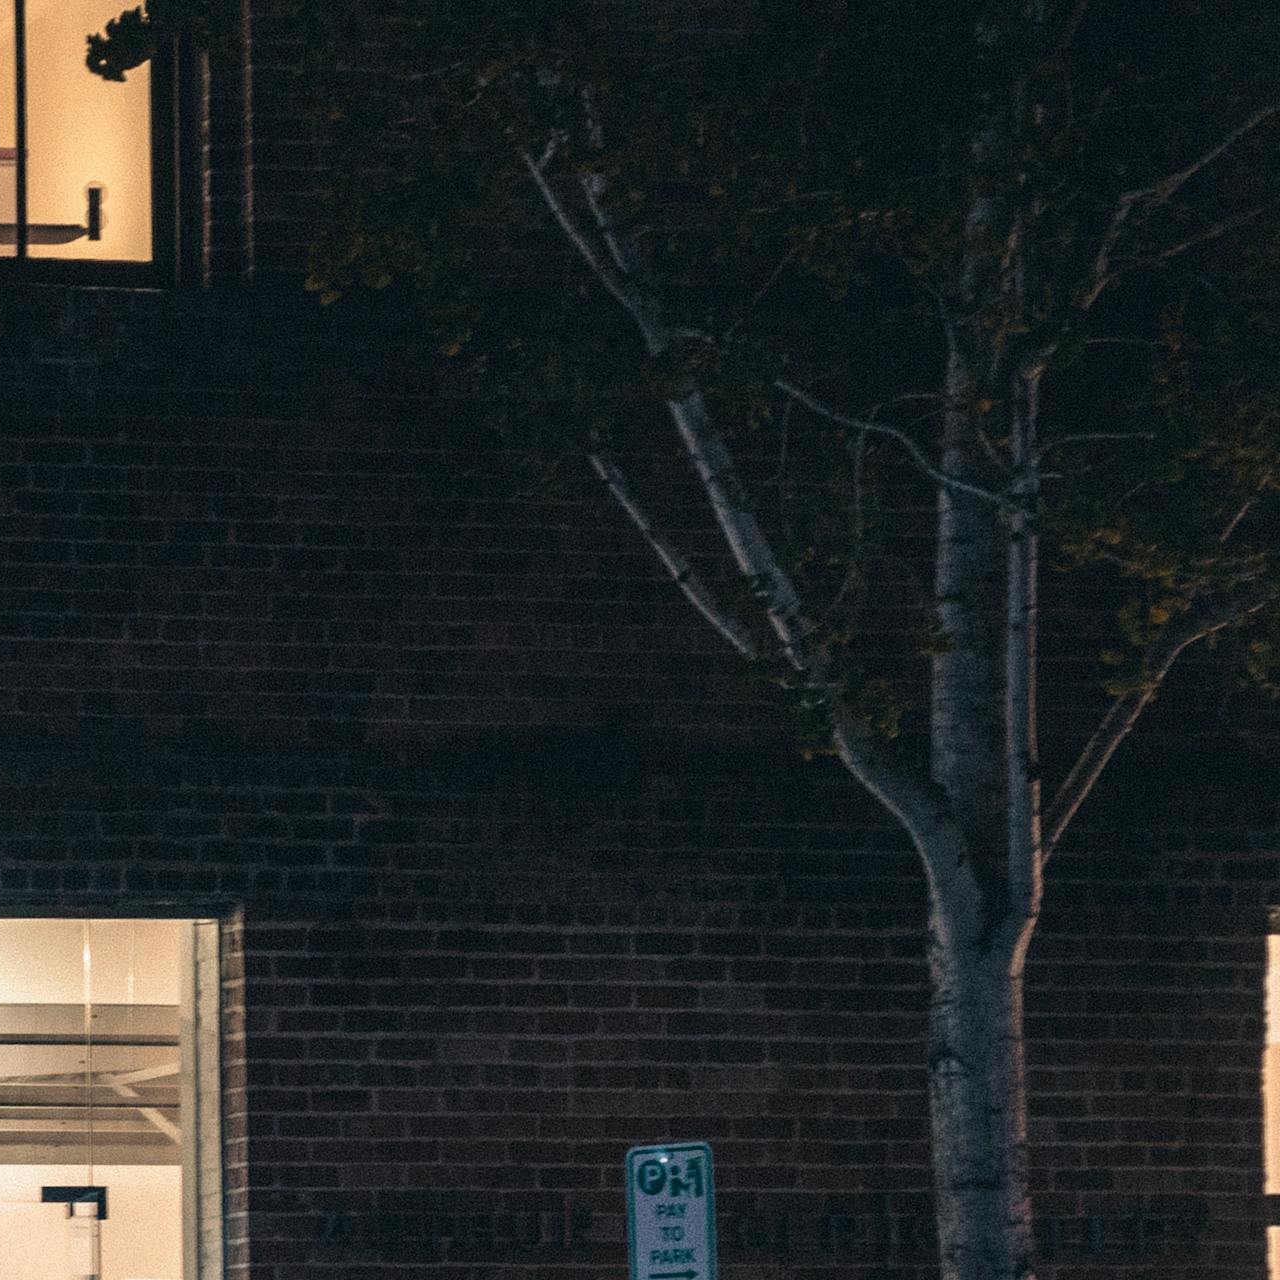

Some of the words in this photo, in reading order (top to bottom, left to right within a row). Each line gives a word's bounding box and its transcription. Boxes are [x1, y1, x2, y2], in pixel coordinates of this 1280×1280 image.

[656, 1203, 688, 1218] PAY
[660, 1225, 685, 1242] TO
[650, 1249, 697, 1265] PARK
